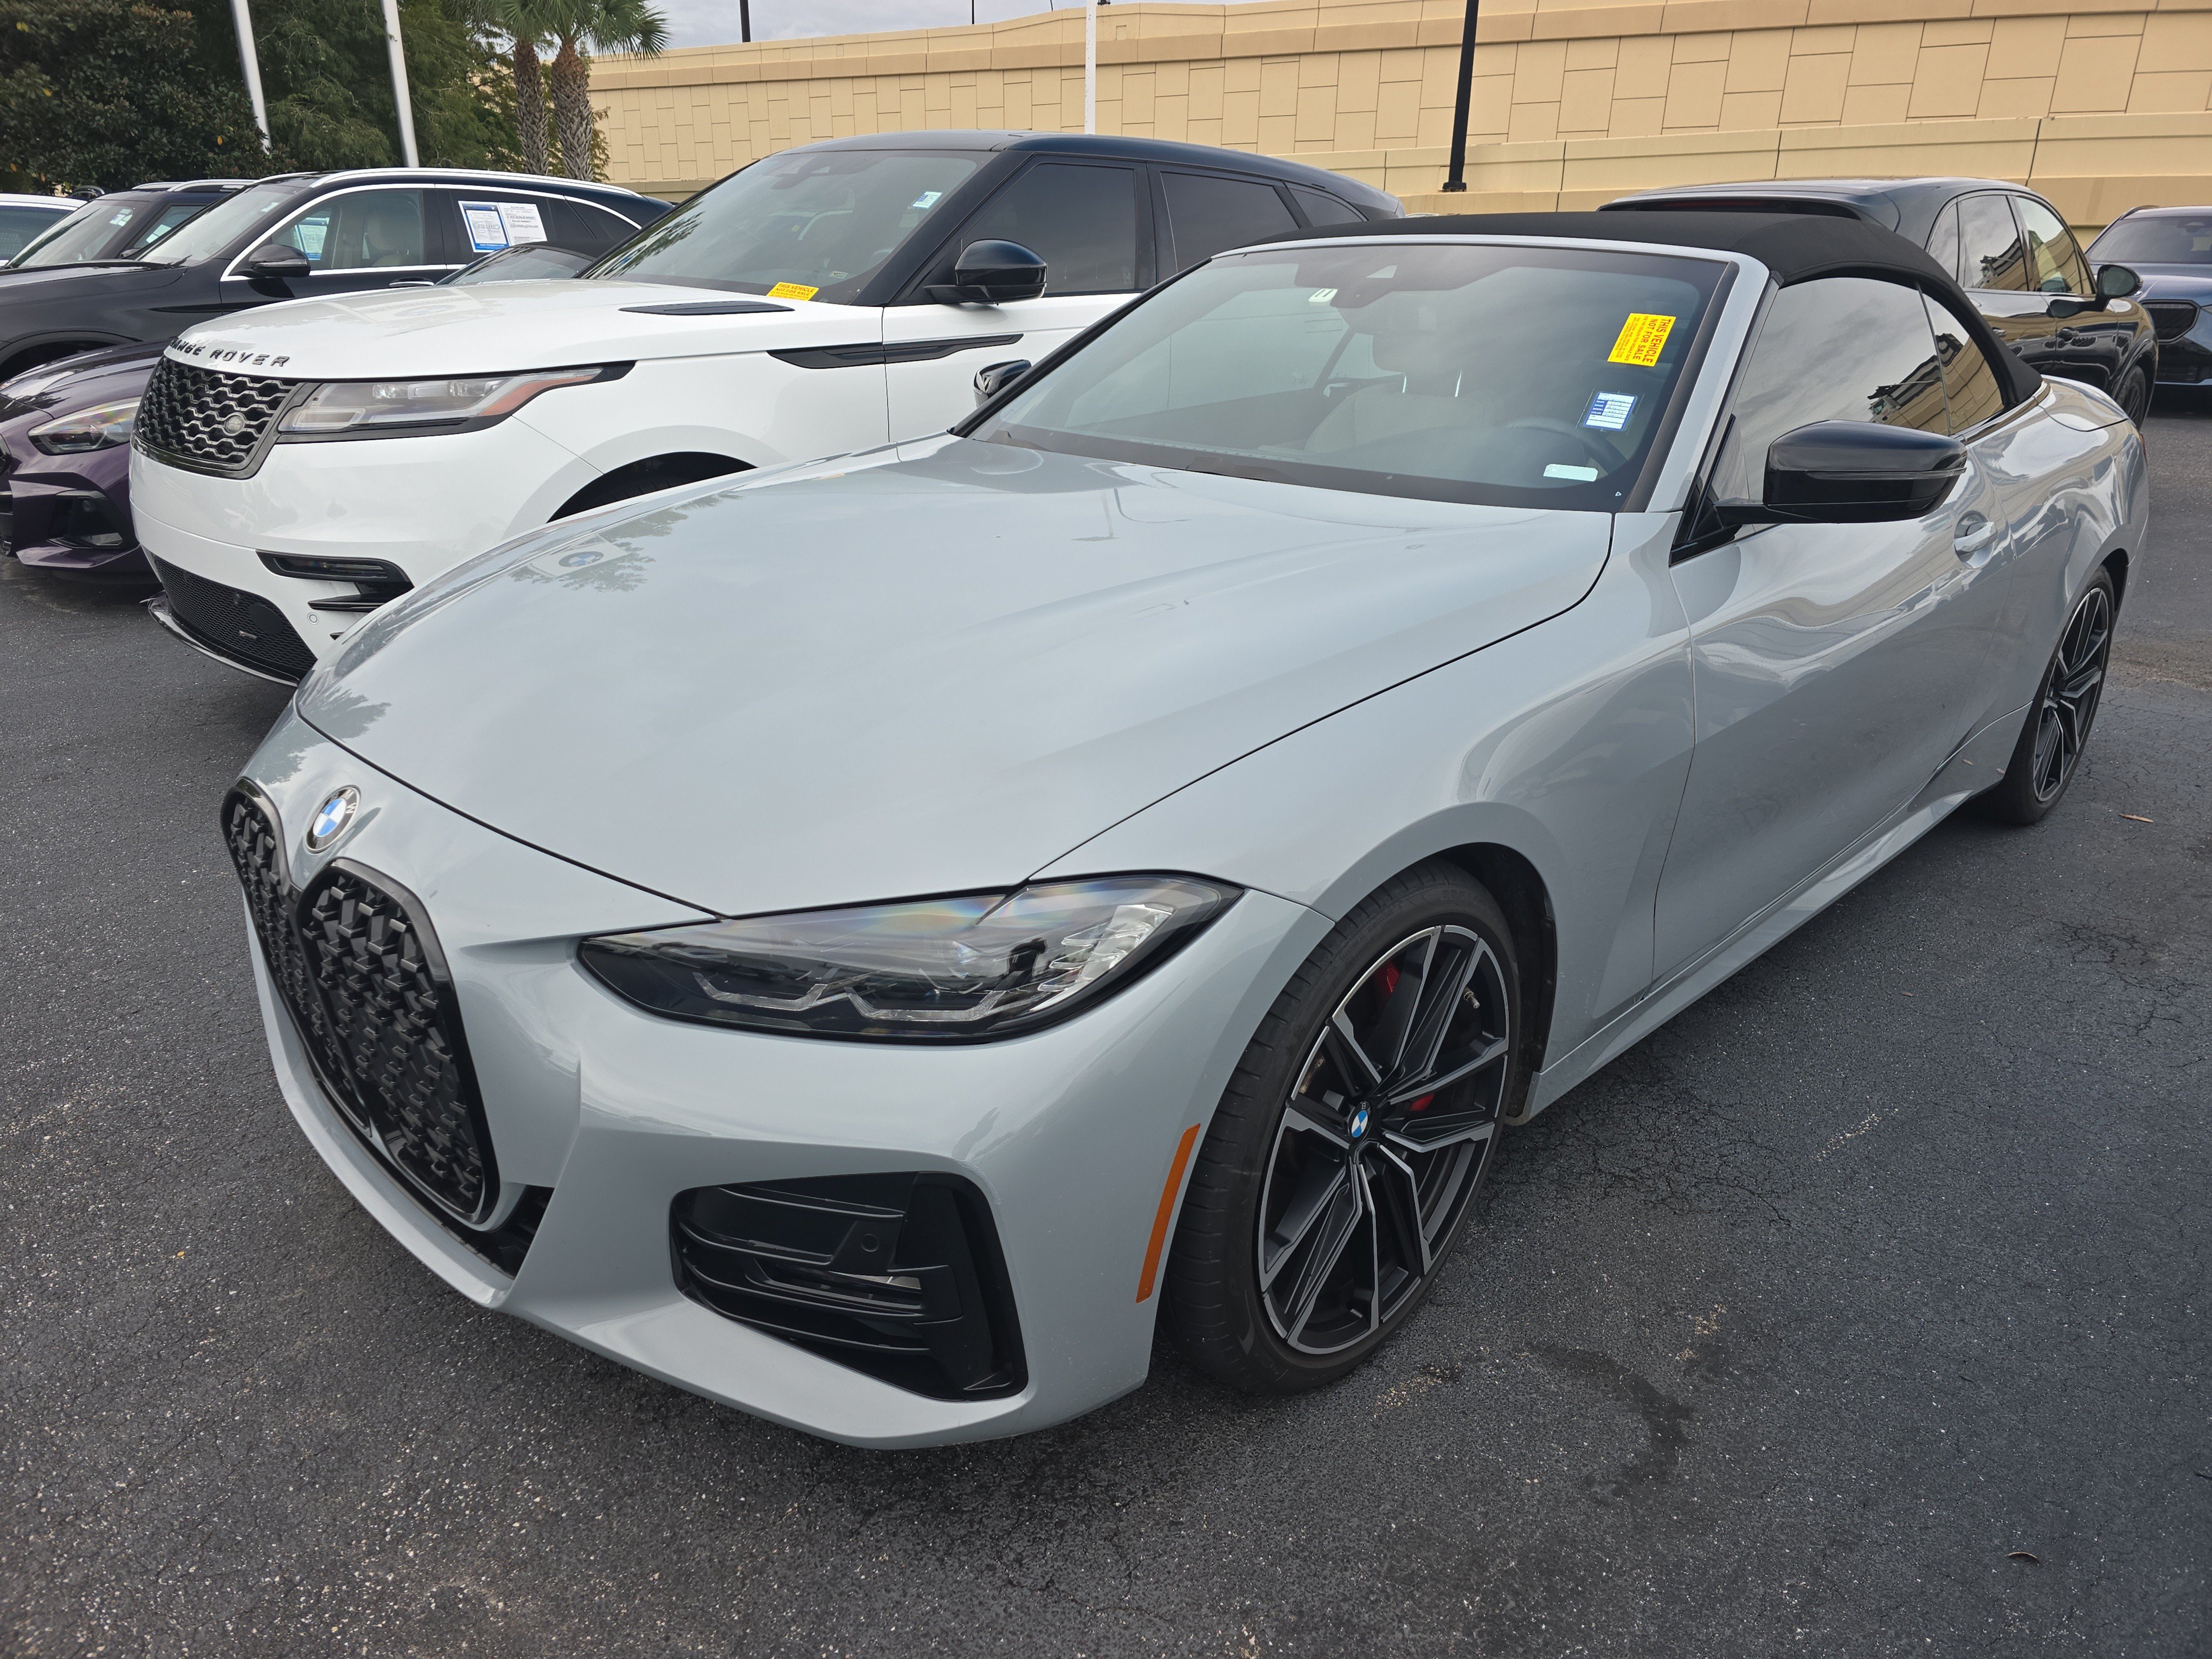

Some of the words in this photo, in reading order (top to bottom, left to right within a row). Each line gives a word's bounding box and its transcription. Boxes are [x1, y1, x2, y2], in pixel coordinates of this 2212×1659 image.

[1647, 319, 1658, 330] NOT
[1656, 319, 1671, 333] THIS
[1640, 331, 1652, 343] FOR
[1632, 344, 1646, 359] SALE
[1642, 335, 1664, 363] VEHICLE
[210, 348, 290, 367] ROVER
